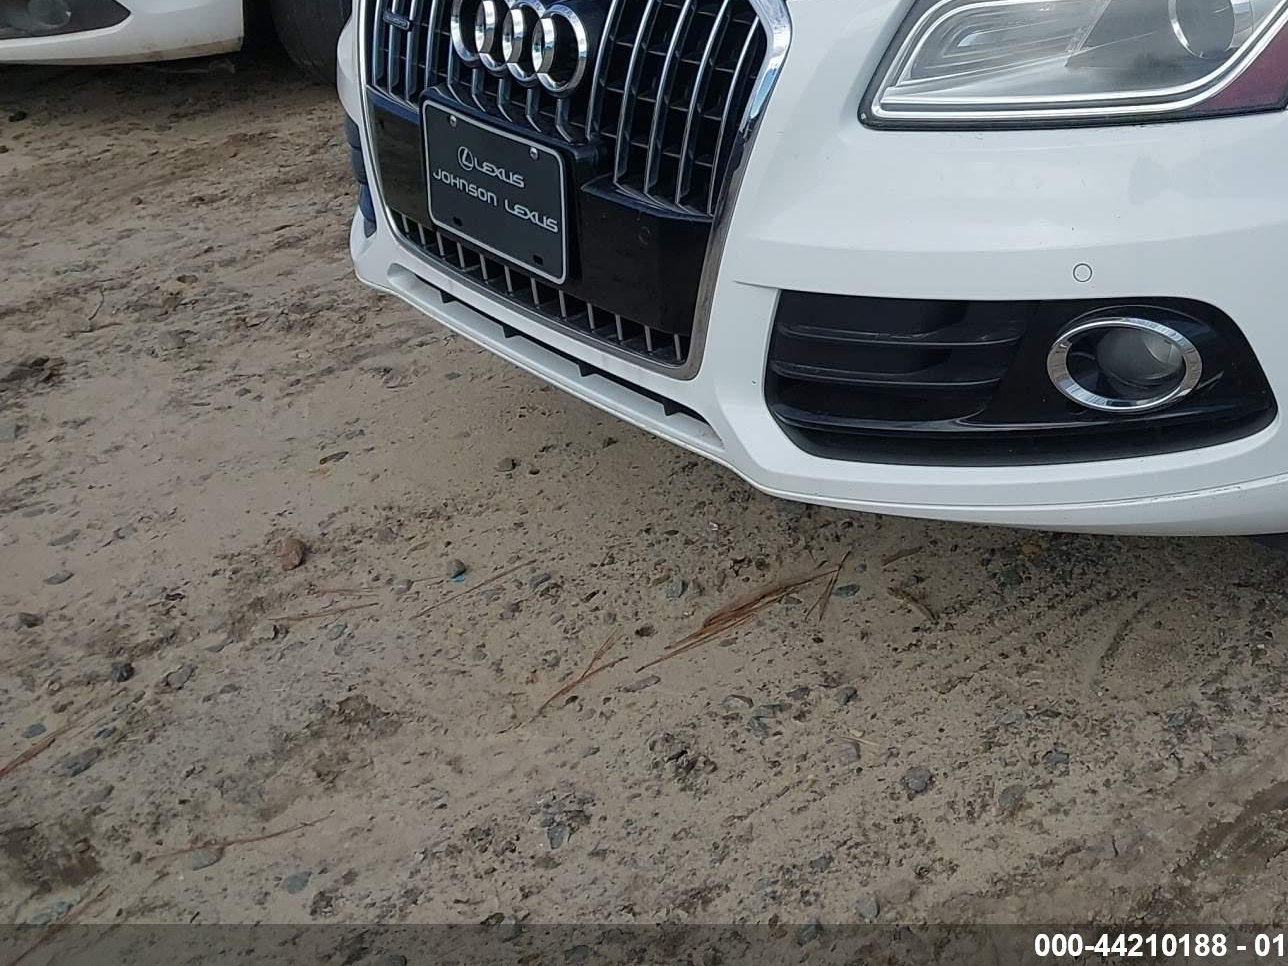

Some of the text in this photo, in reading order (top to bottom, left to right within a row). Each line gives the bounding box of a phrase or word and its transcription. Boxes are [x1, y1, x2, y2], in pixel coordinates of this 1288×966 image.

[474, 156, 525, 188] LEXUS
[433, 168, 559, 233] JOHNSON LEXUS
